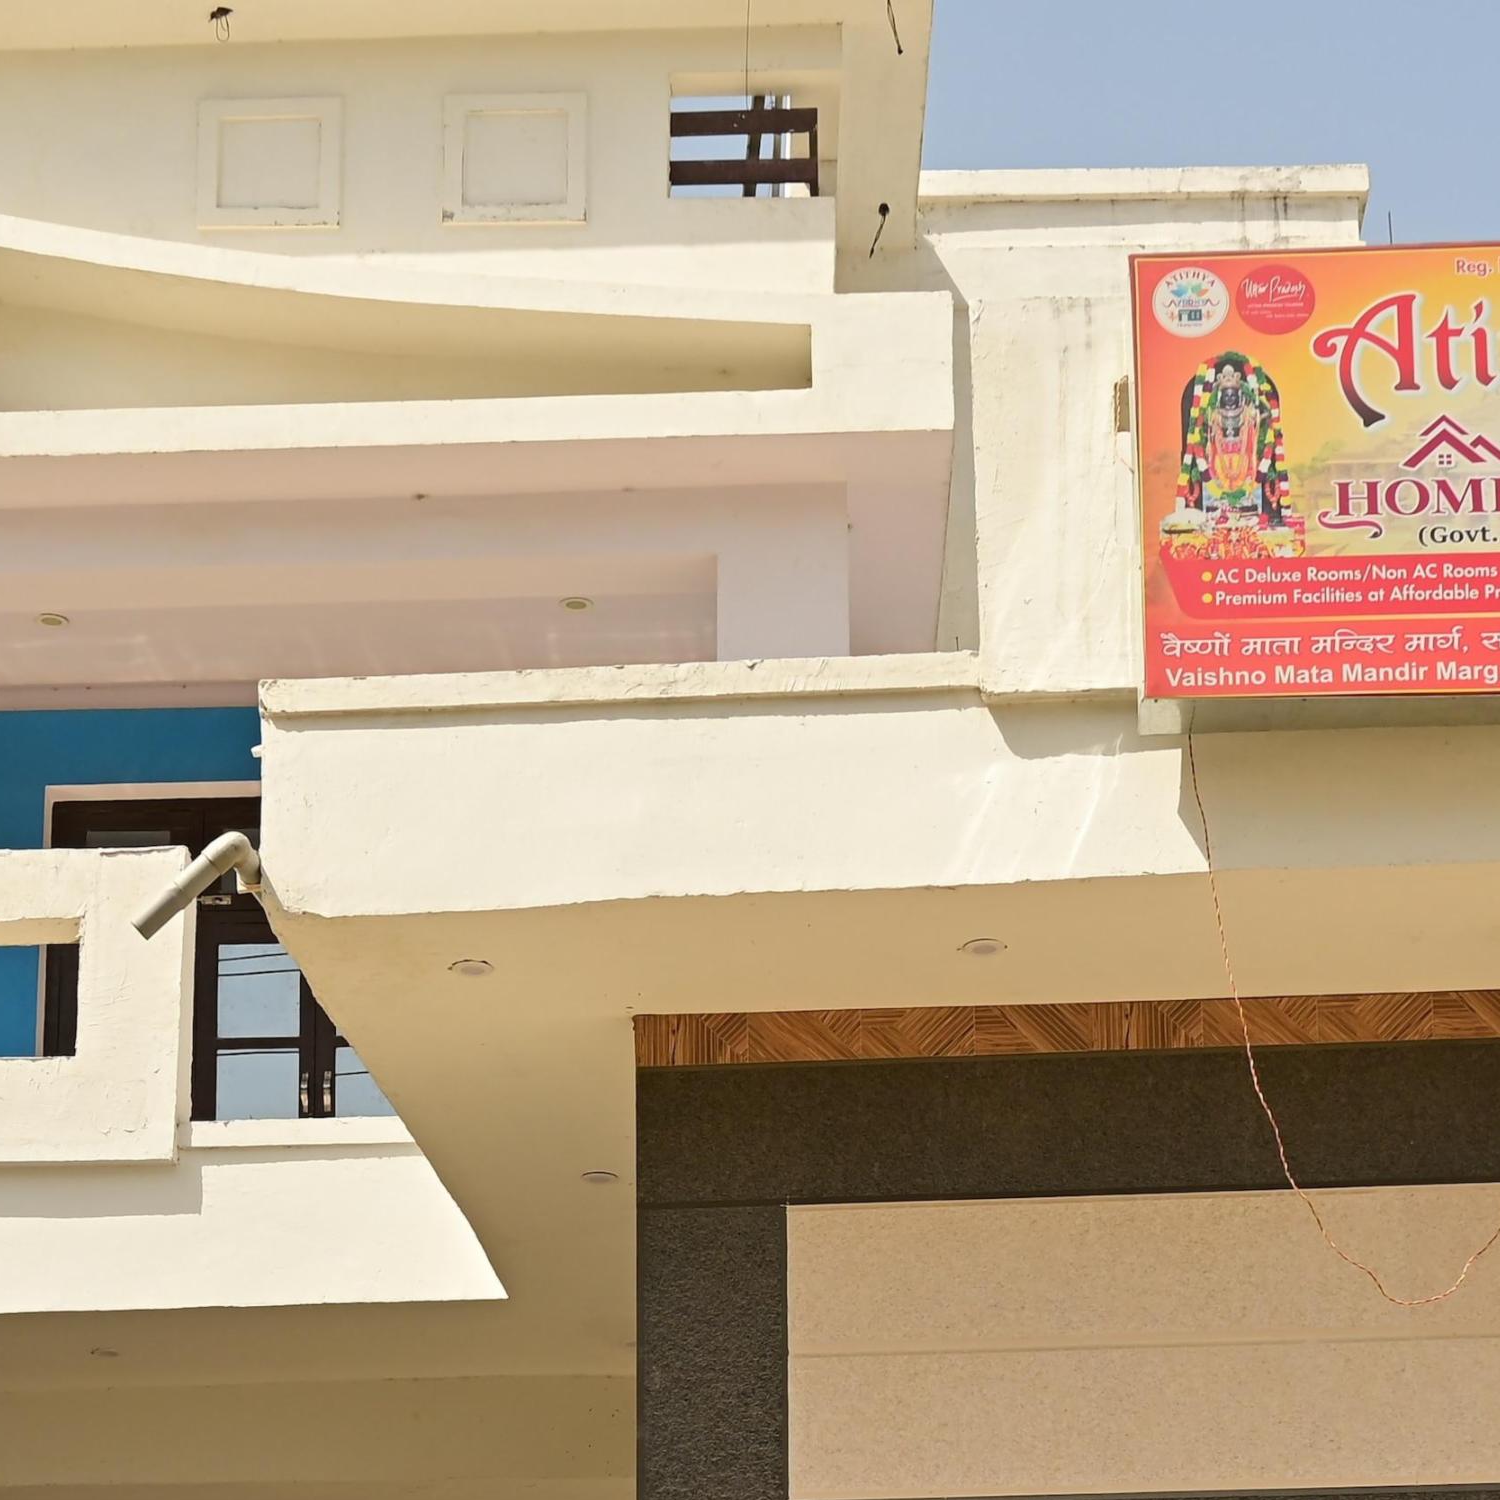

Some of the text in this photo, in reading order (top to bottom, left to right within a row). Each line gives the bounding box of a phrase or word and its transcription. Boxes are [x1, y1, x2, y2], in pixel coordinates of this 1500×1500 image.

[1455, 259, 1492, 276] Reg.
[1418, 525, 1498, 546] (Govt.
[1215, 563, 1498, 584] AC Deluxe Rooms/Non AC Rooms
[1215, 590, 1287, 606] Premium
[1294, 587, 1363, 605] Facilities
[1368, 588, 1385, 602] at
[1390, 583, 1479, 601] Affordable
[1240, 637, 1302, 656] माता
[1310, 628, 1395, 655] मन्दिर
[1404, 625, 1469, 654] मार्ग,
[1165, 666, 1267, 687] Vaishno
[1274, 665, 1334, 684] Mata
[1342, 662, 1429, 684] Mandir
